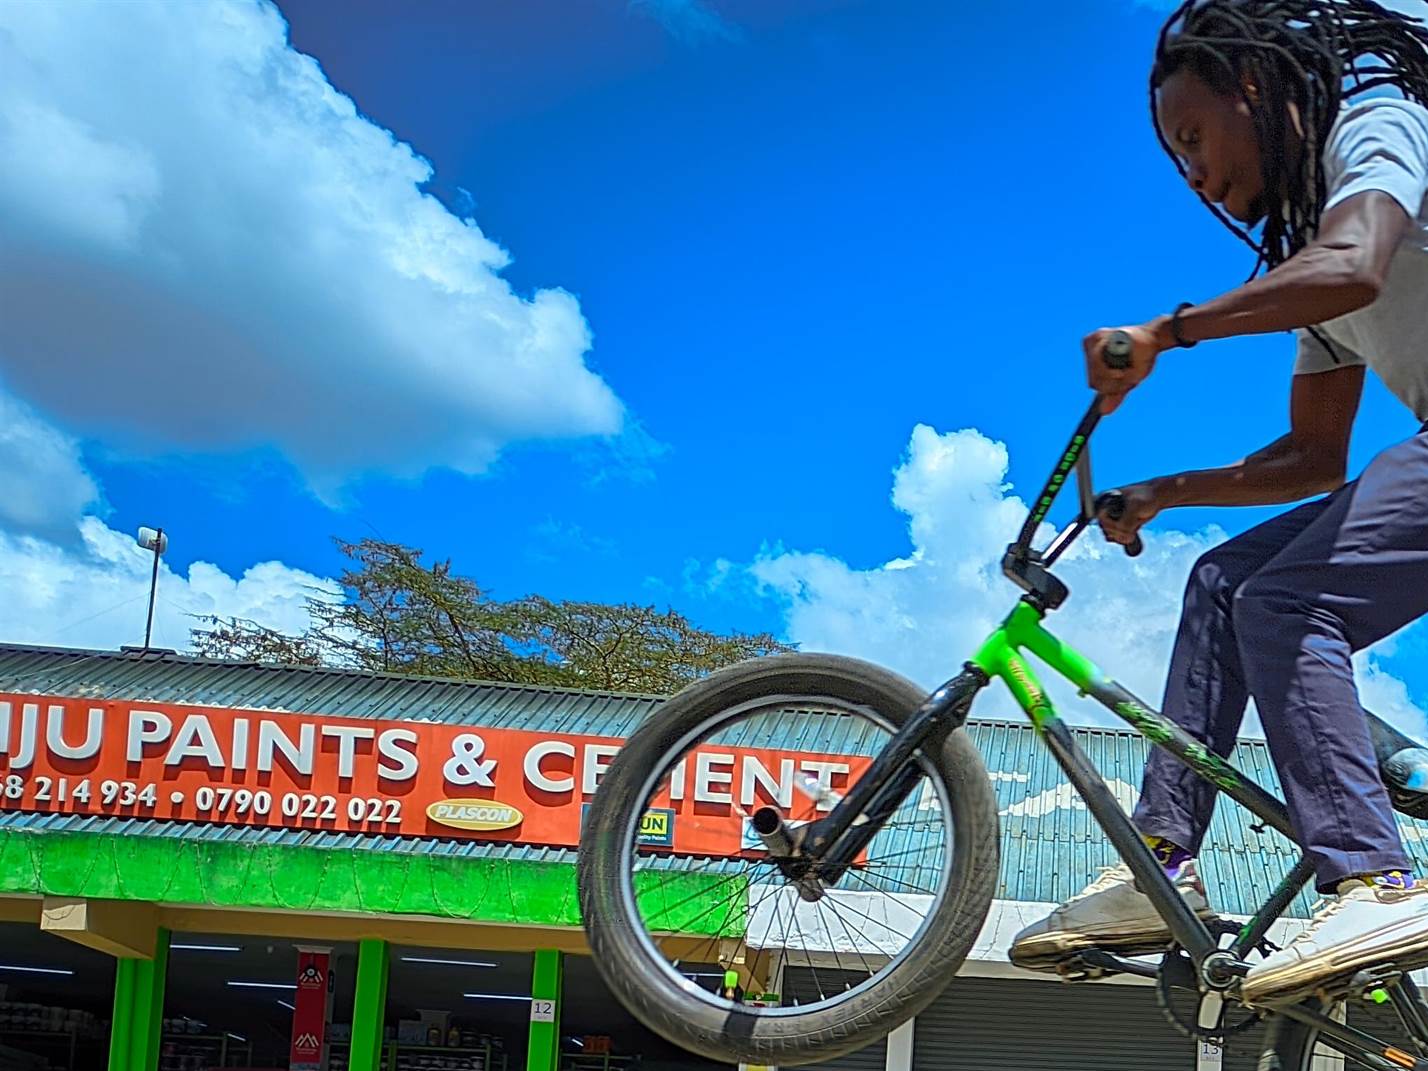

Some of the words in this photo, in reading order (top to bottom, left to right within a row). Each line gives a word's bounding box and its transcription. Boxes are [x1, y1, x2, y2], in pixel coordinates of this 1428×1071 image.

[126, 710, 420, 782] PAINTS
[442, 733, 497, 788] &
[523, 741, 849, 813] CEENT
[34, 775, 91, 804] 214
[101, 781, 157, 808] 934
[195, 788, 271, 817] 0790
[281, 793, 337, 821] 022
[347, 799, 402, 824] 022
[434, 804, 513, 823] PLASCON
[535, 1002, 552, 1015] 12
[1203, 1044, 1219, 1055] 13
